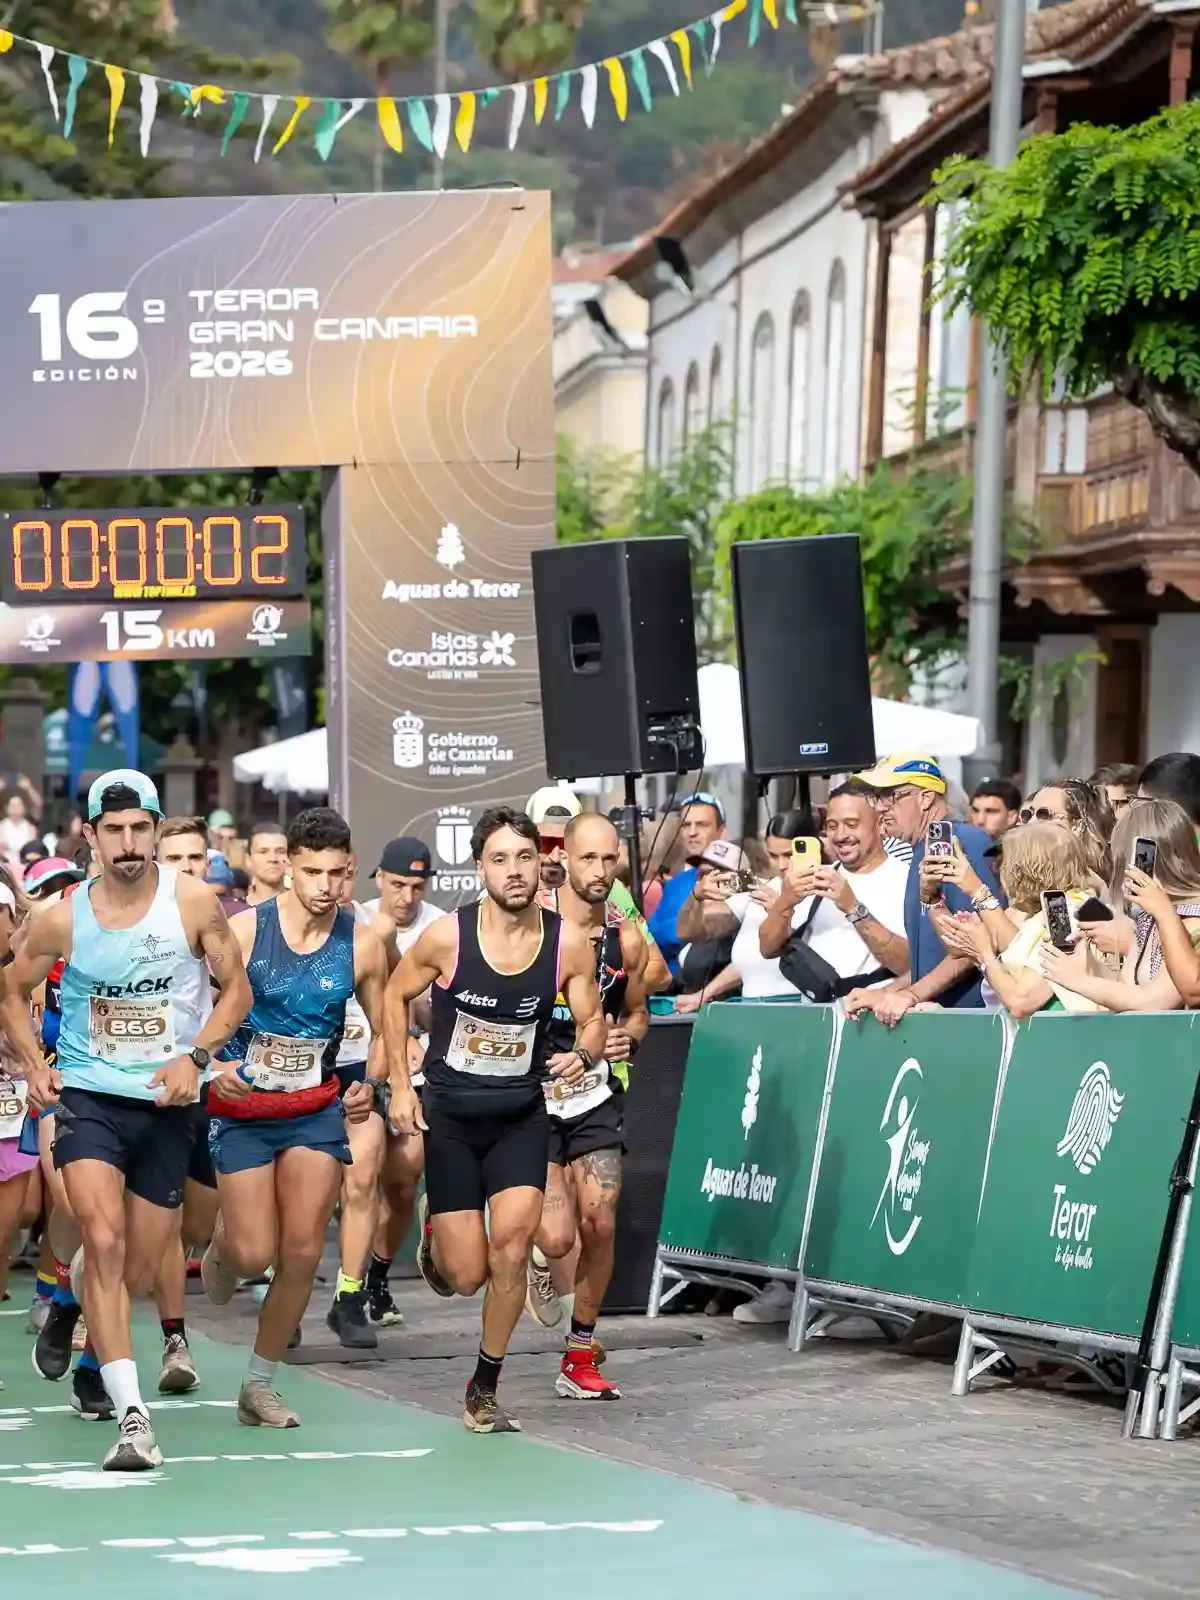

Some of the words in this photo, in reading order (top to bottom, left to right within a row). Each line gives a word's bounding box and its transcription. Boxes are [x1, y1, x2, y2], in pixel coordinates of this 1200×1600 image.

[188, 287, 319, 313] TEROR
[188, 319, 294, 344] GRAN
[314, 315, 478, 342] CANARIA
[189, 350, 293, 378] 2026
[32, 366, 138, 383] EDICIÓN
[13, 515, 289, 591] 00:00:02
[382, 580, 441, 603] Aguas
[443, 579, 469, 598] de
[470, 579, 521, 598] Teror
[99, 609, 164, 650] 15
[167, 629, 215, 648] KM
[431, 632, 478, 650] Islas
[387, 648, 478, 667] Canarias
[428, 732, 498, 747] Gobierno
[428, 748, 447, 761] de
[448, 747, 513, 761] Canarias
[93, 976, 173, 998] TRACK
[110, 1020, 161, 1035] 866
[478, 1040, 518, 1056] 671
[270, 1053, 310, 1071] 955
[700, 1157, 735, 1202] Aguas
[733, 1162, 749, 1199] de
[748, 1164, 777, 1203] Teror
[1049, 1184, 1097, 1241] Teror
[163, 1448, 435, 1464] Agua
